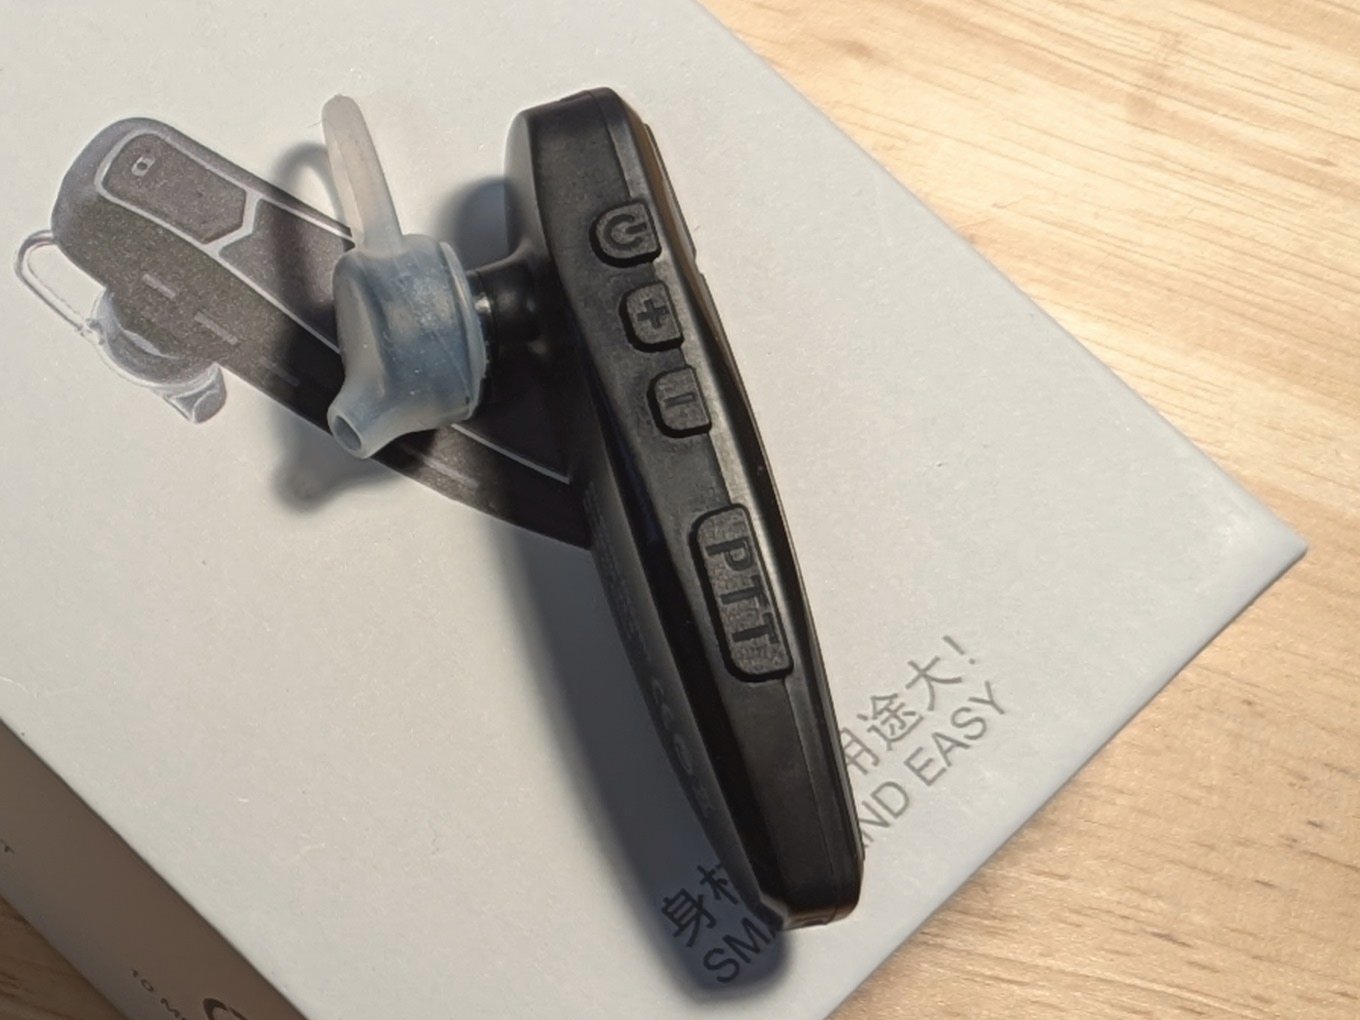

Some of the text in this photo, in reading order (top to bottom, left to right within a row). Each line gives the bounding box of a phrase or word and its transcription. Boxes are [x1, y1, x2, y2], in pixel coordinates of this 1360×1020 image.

[707, 536, 779, 645] PTT
[857, 681, 1006, 848] ND EASY
[703, 917, 775, 984] SM
